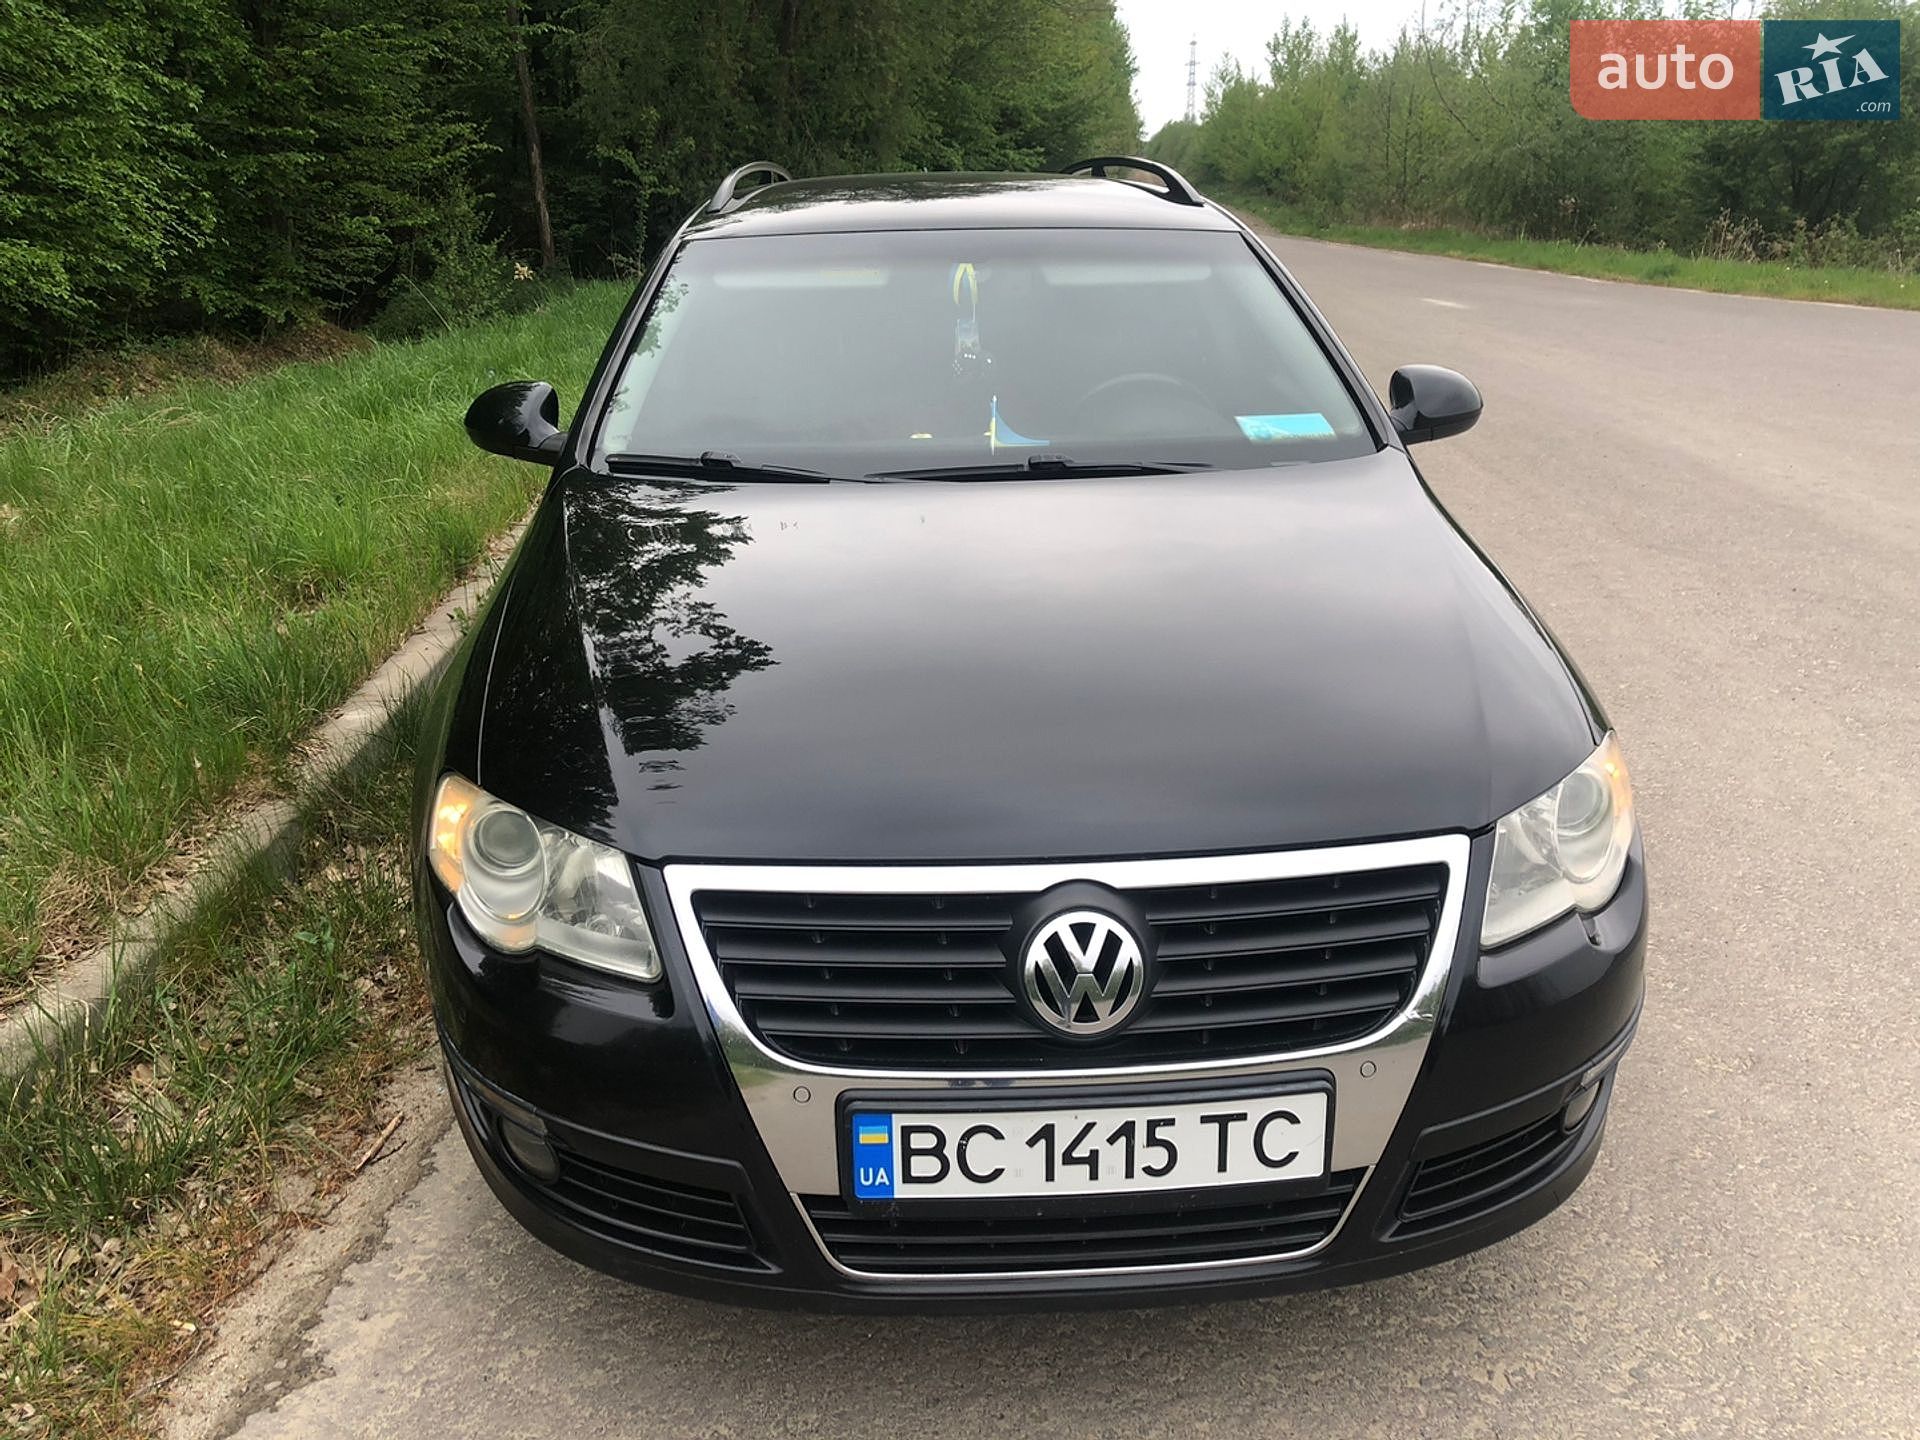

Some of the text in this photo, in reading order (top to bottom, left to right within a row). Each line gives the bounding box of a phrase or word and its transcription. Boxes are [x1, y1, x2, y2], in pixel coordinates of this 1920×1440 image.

[900, 1110, 1301, 1185] BC 1415 TC
[860, 1167, 889, 1186] UA
